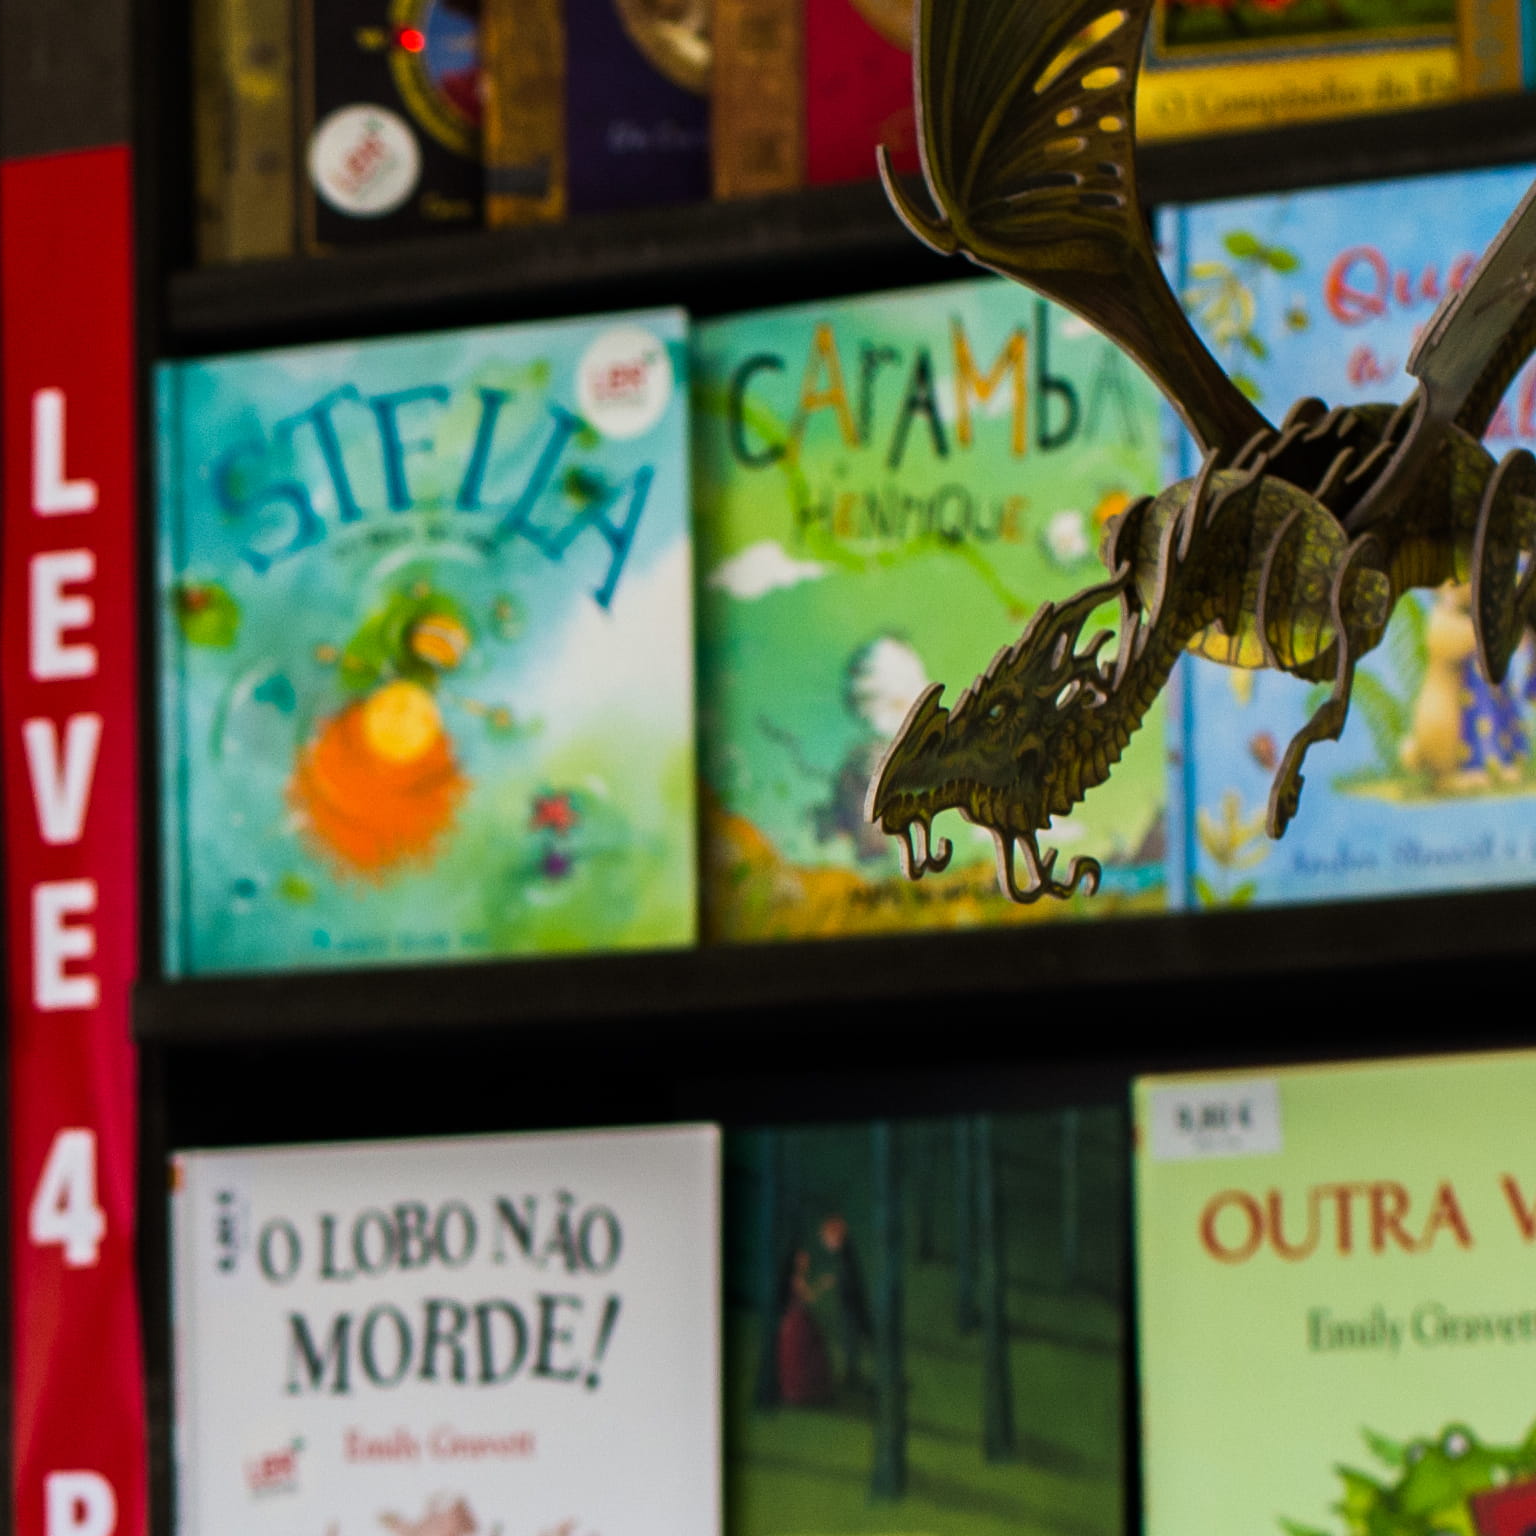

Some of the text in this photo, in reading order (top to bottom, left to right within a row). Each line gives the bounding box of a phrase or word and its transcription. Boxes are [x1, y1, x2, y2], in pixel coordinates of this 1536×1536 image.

[24, 388, 101, 1010] LEVE
[29, 1129, 106, 1266] 4
[257, 1215, 303, 1285] O
[318, 1201, 478, 1283] LOBO
[491, 1187, 625, 1277] NÃO
[1198, 1178, 1475, 1267] OUTRA
[285, 1291, 623, 1397] MORDE!
[1306, 1301, 1403, 1358] Emily
